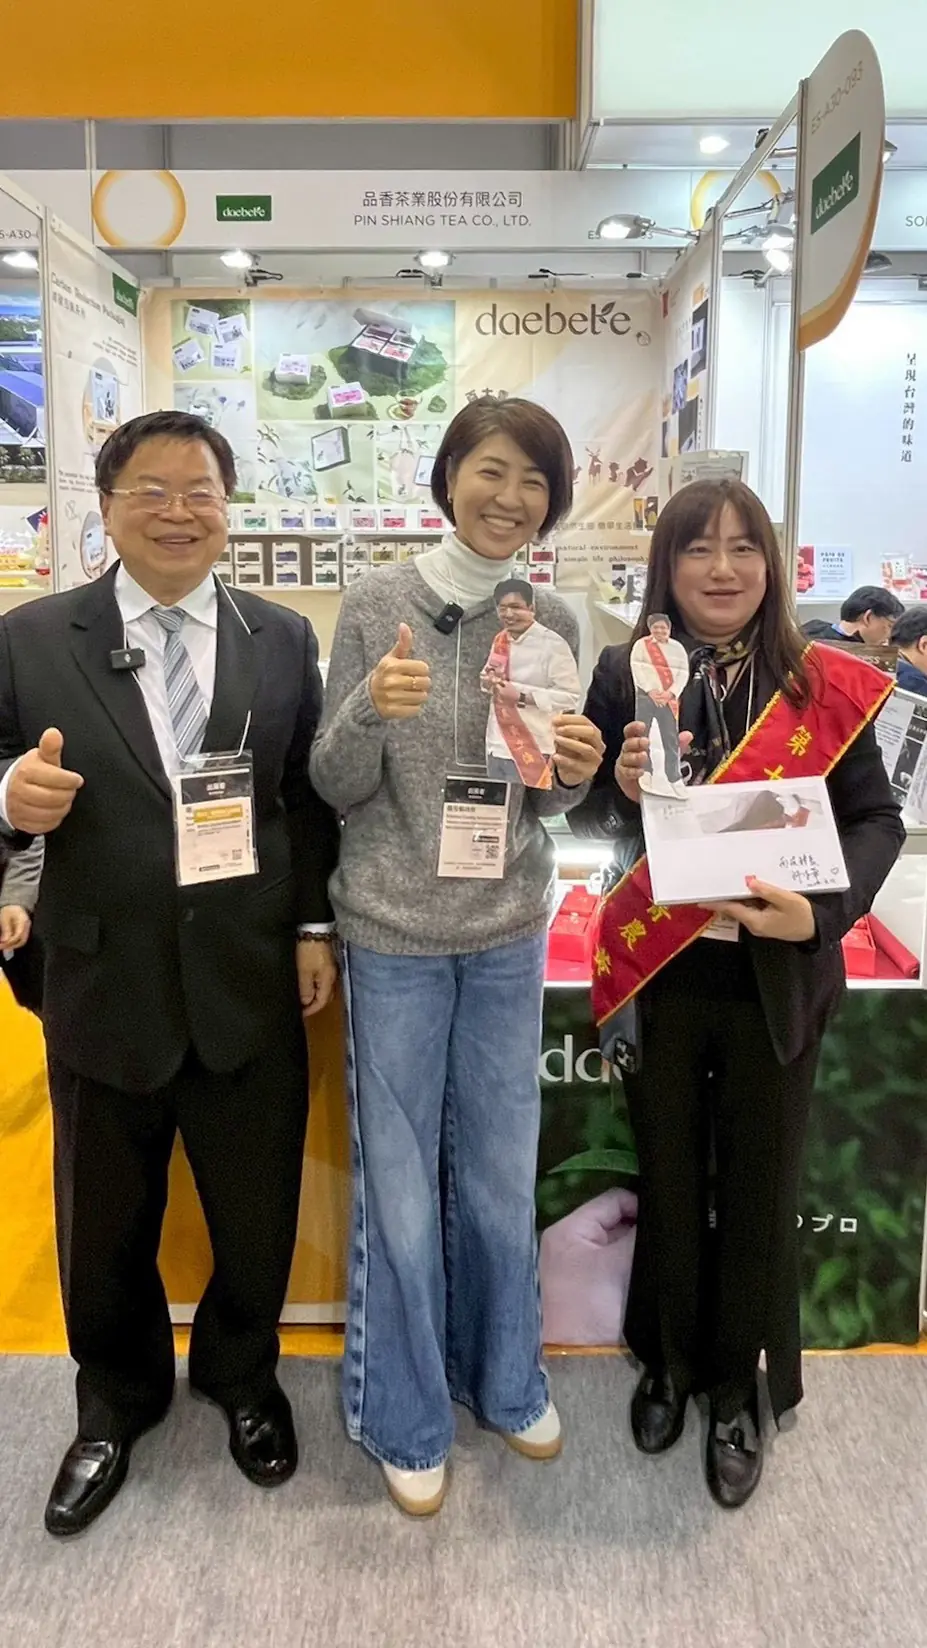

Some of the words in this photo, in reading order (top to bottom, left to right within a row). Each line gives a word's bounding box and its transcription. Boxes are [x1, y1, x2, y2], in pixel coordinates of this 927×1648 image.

[363, 190, 523, 208] 品香茶業股份有限公司
[354, 215, 377, 226] PIN
[381, 214, 435, 226] SHIANG
[440, 215, 468, 226] TEA
[472, 214, 499, 228] CO.,
[503, 215, 531, 226] LTD.
